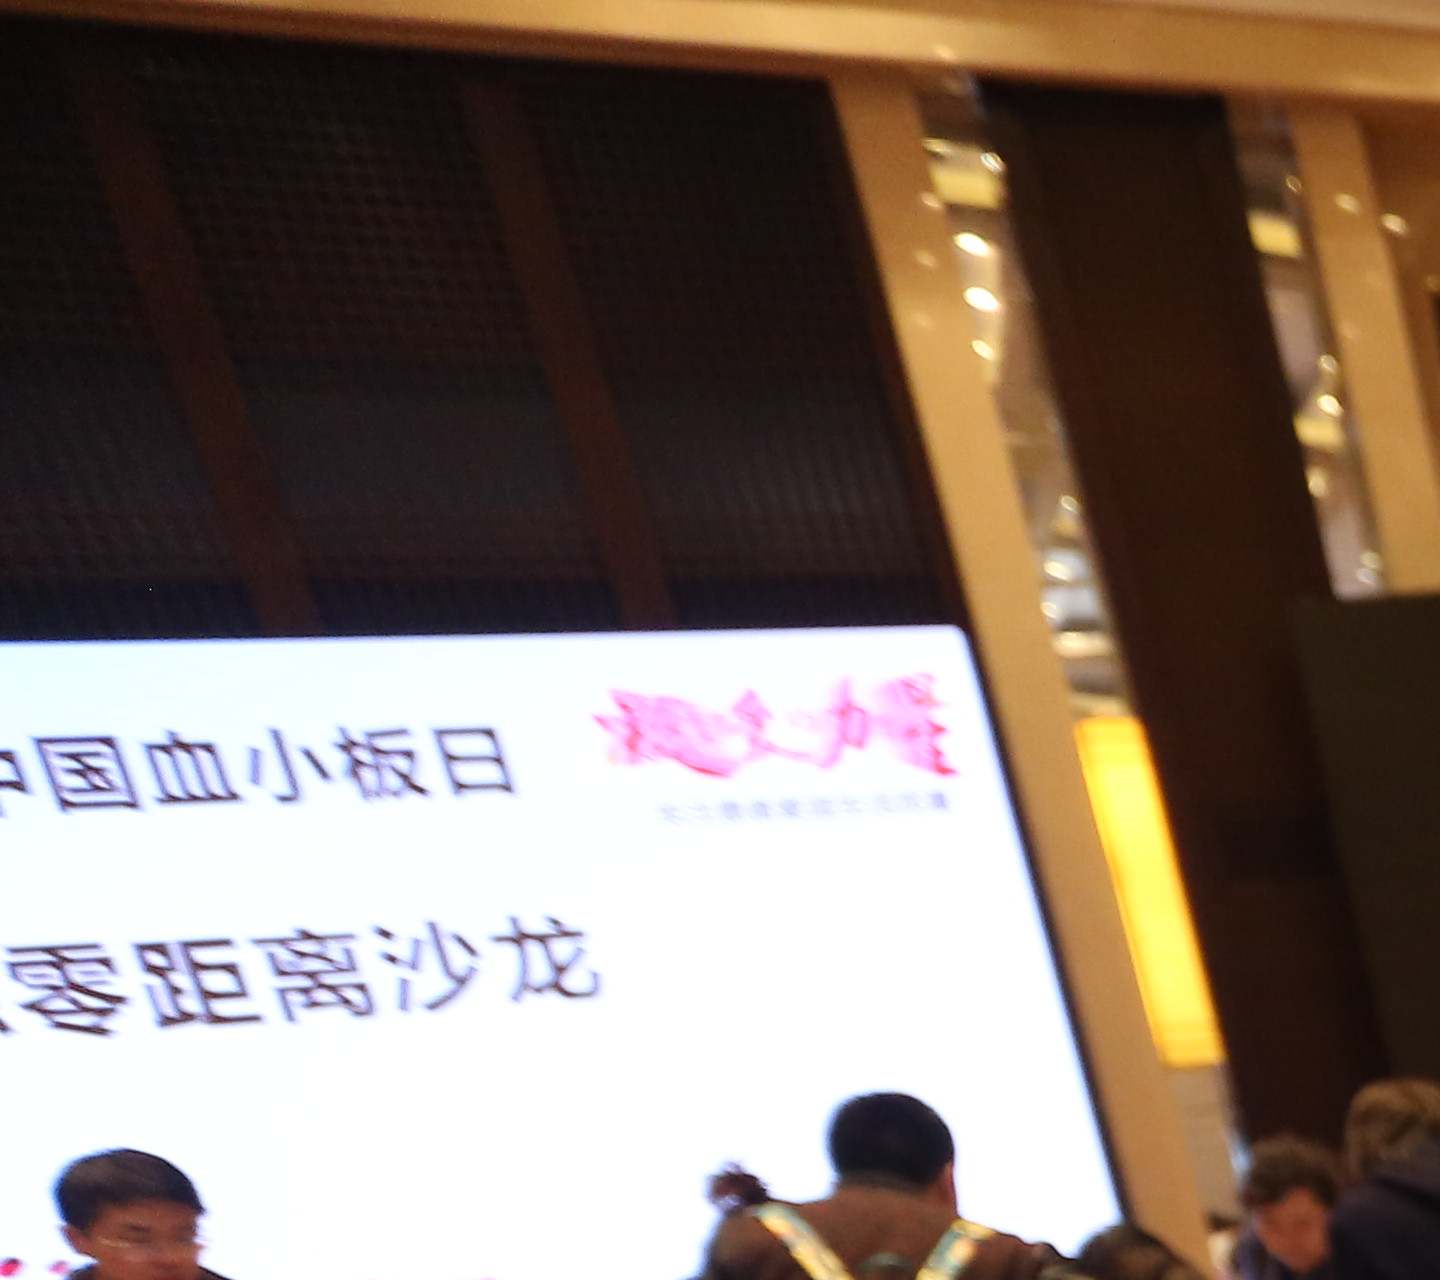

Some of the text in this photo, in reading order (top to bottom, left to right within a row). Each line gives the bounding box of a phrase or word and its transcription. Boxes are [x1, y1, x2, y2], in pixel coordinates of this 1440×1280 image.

[0, 915, 602, 1037] 零距离沙龙
